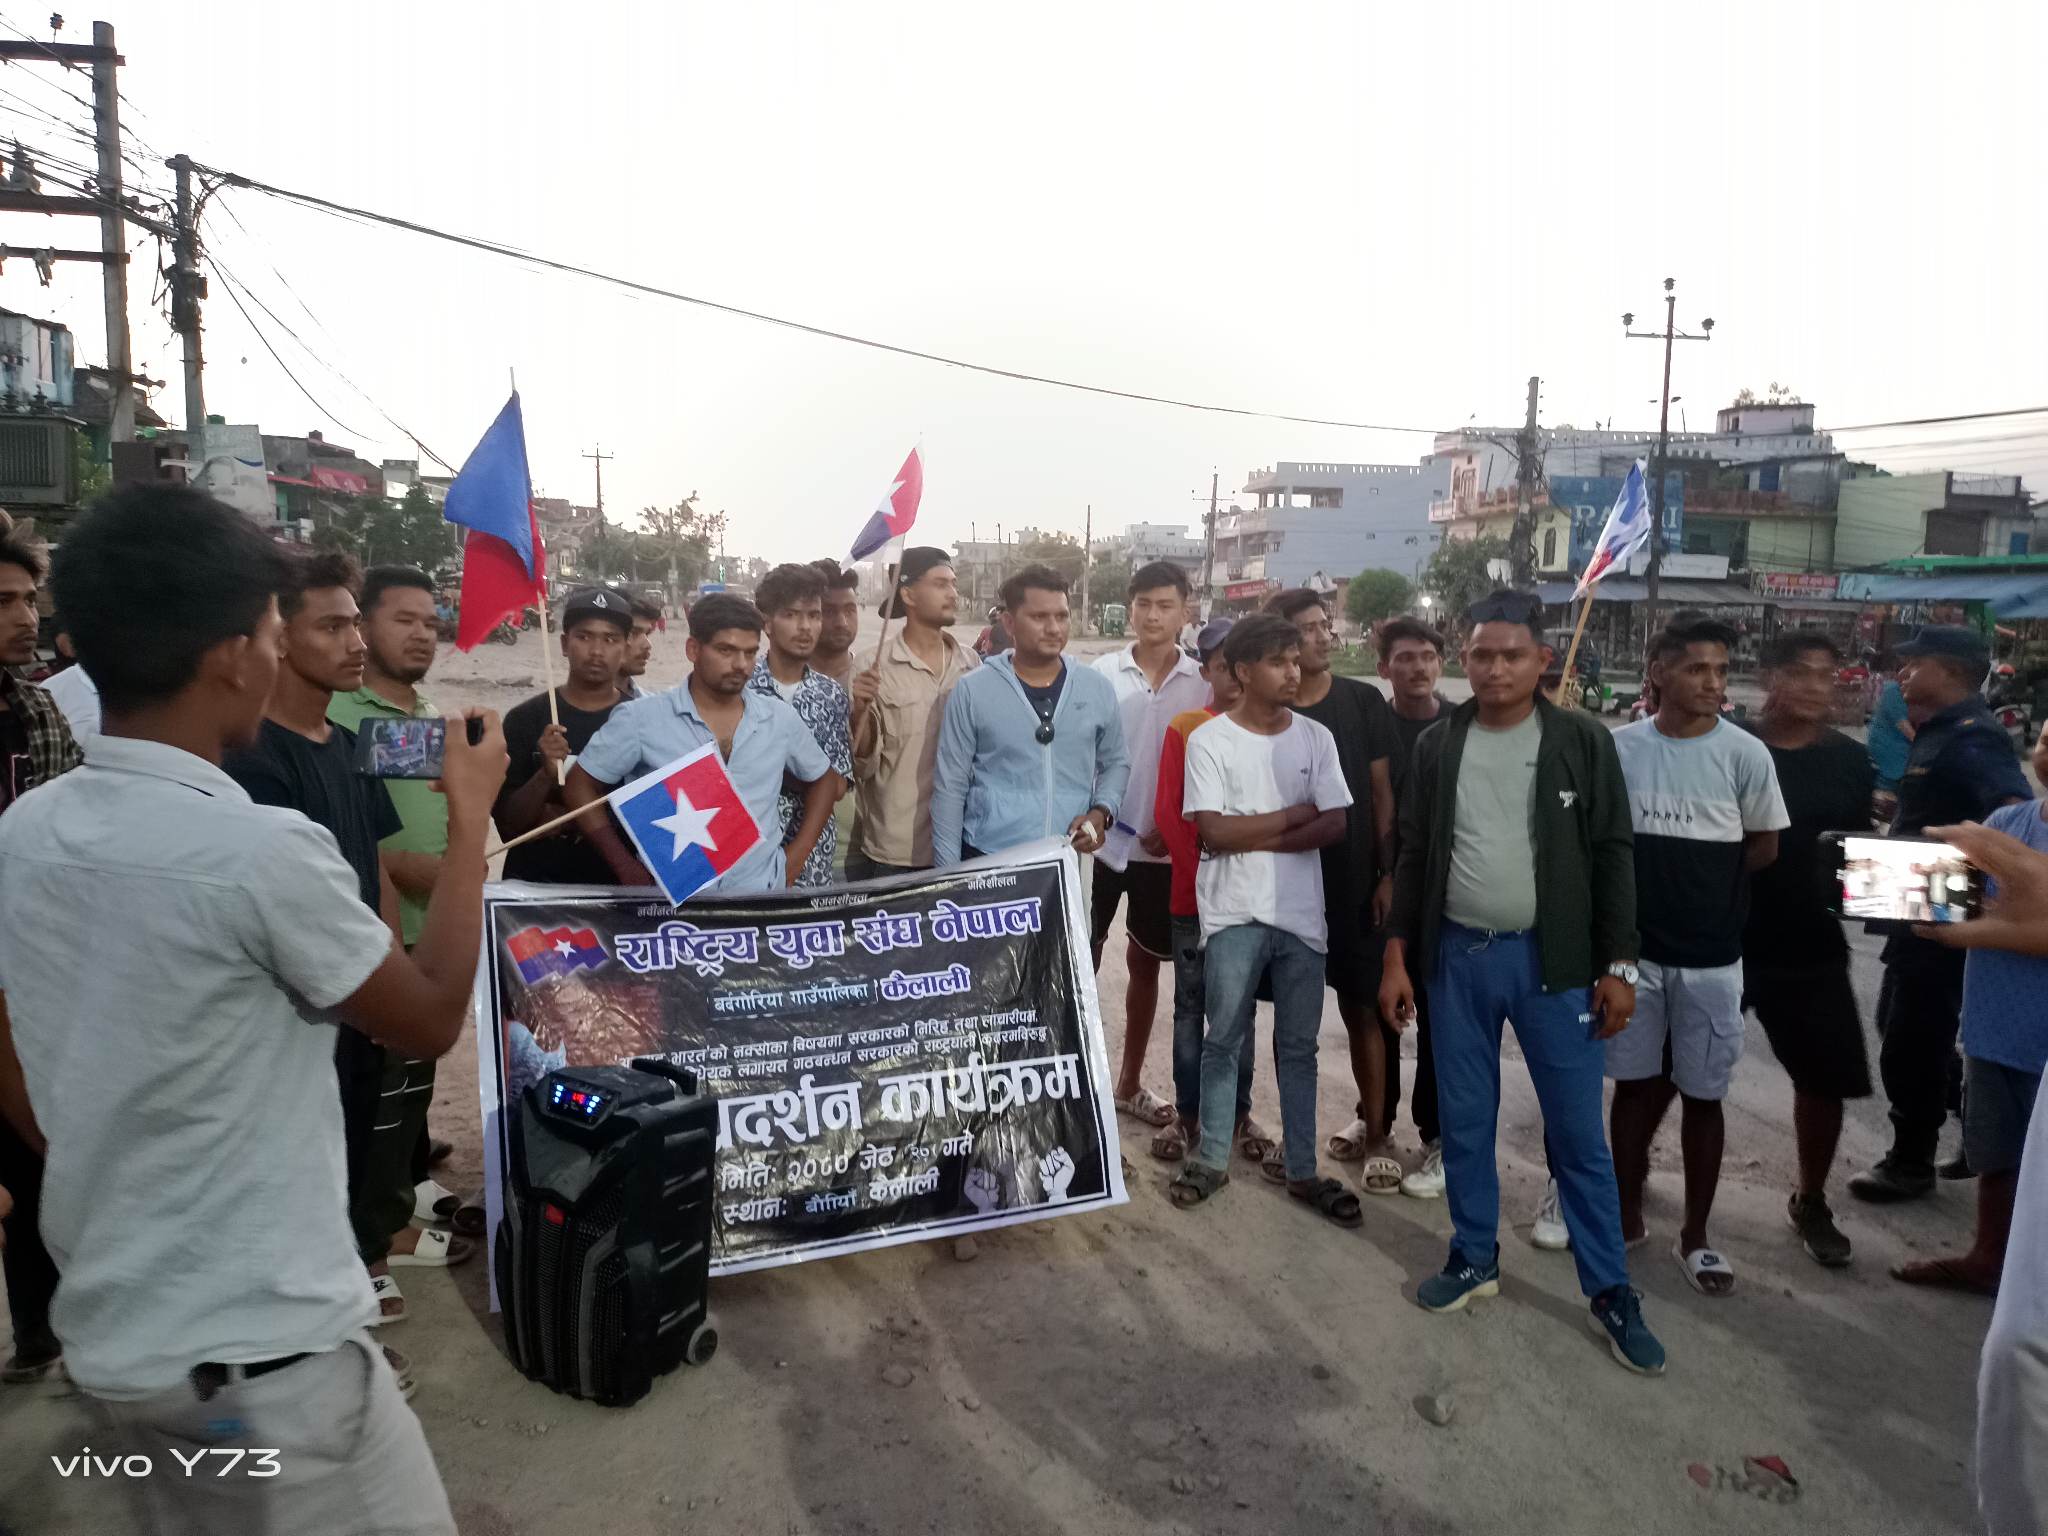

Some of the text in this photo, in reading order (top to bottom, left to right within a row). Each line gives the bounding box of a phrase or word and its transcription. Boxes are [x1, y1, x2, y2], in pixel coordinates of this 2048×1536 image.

[967, 875, 1017, 891] गतिशीलता
[614, 897, 1041, 977] राष्ट्रिय युवा संघ नेपाल
[880, 963, 971, 1001] कैलाली
[848, 1022, 910, 1046] सरकारको
[954, 1015, 979, 1035] तथा
[738, 1059, 788, 1077] लगायत
[792, 1051, 853, 1071] गठबन्धन
[857, 1039, 919, 1063] सरकारको
[877, 1052, 1081, 1123] कार्यक्रम
[859, 1143, 897, 1171] जेठ
[941, 1130, 976, 1157] गते
[868, 1166, 940, 1202] कैलाली
